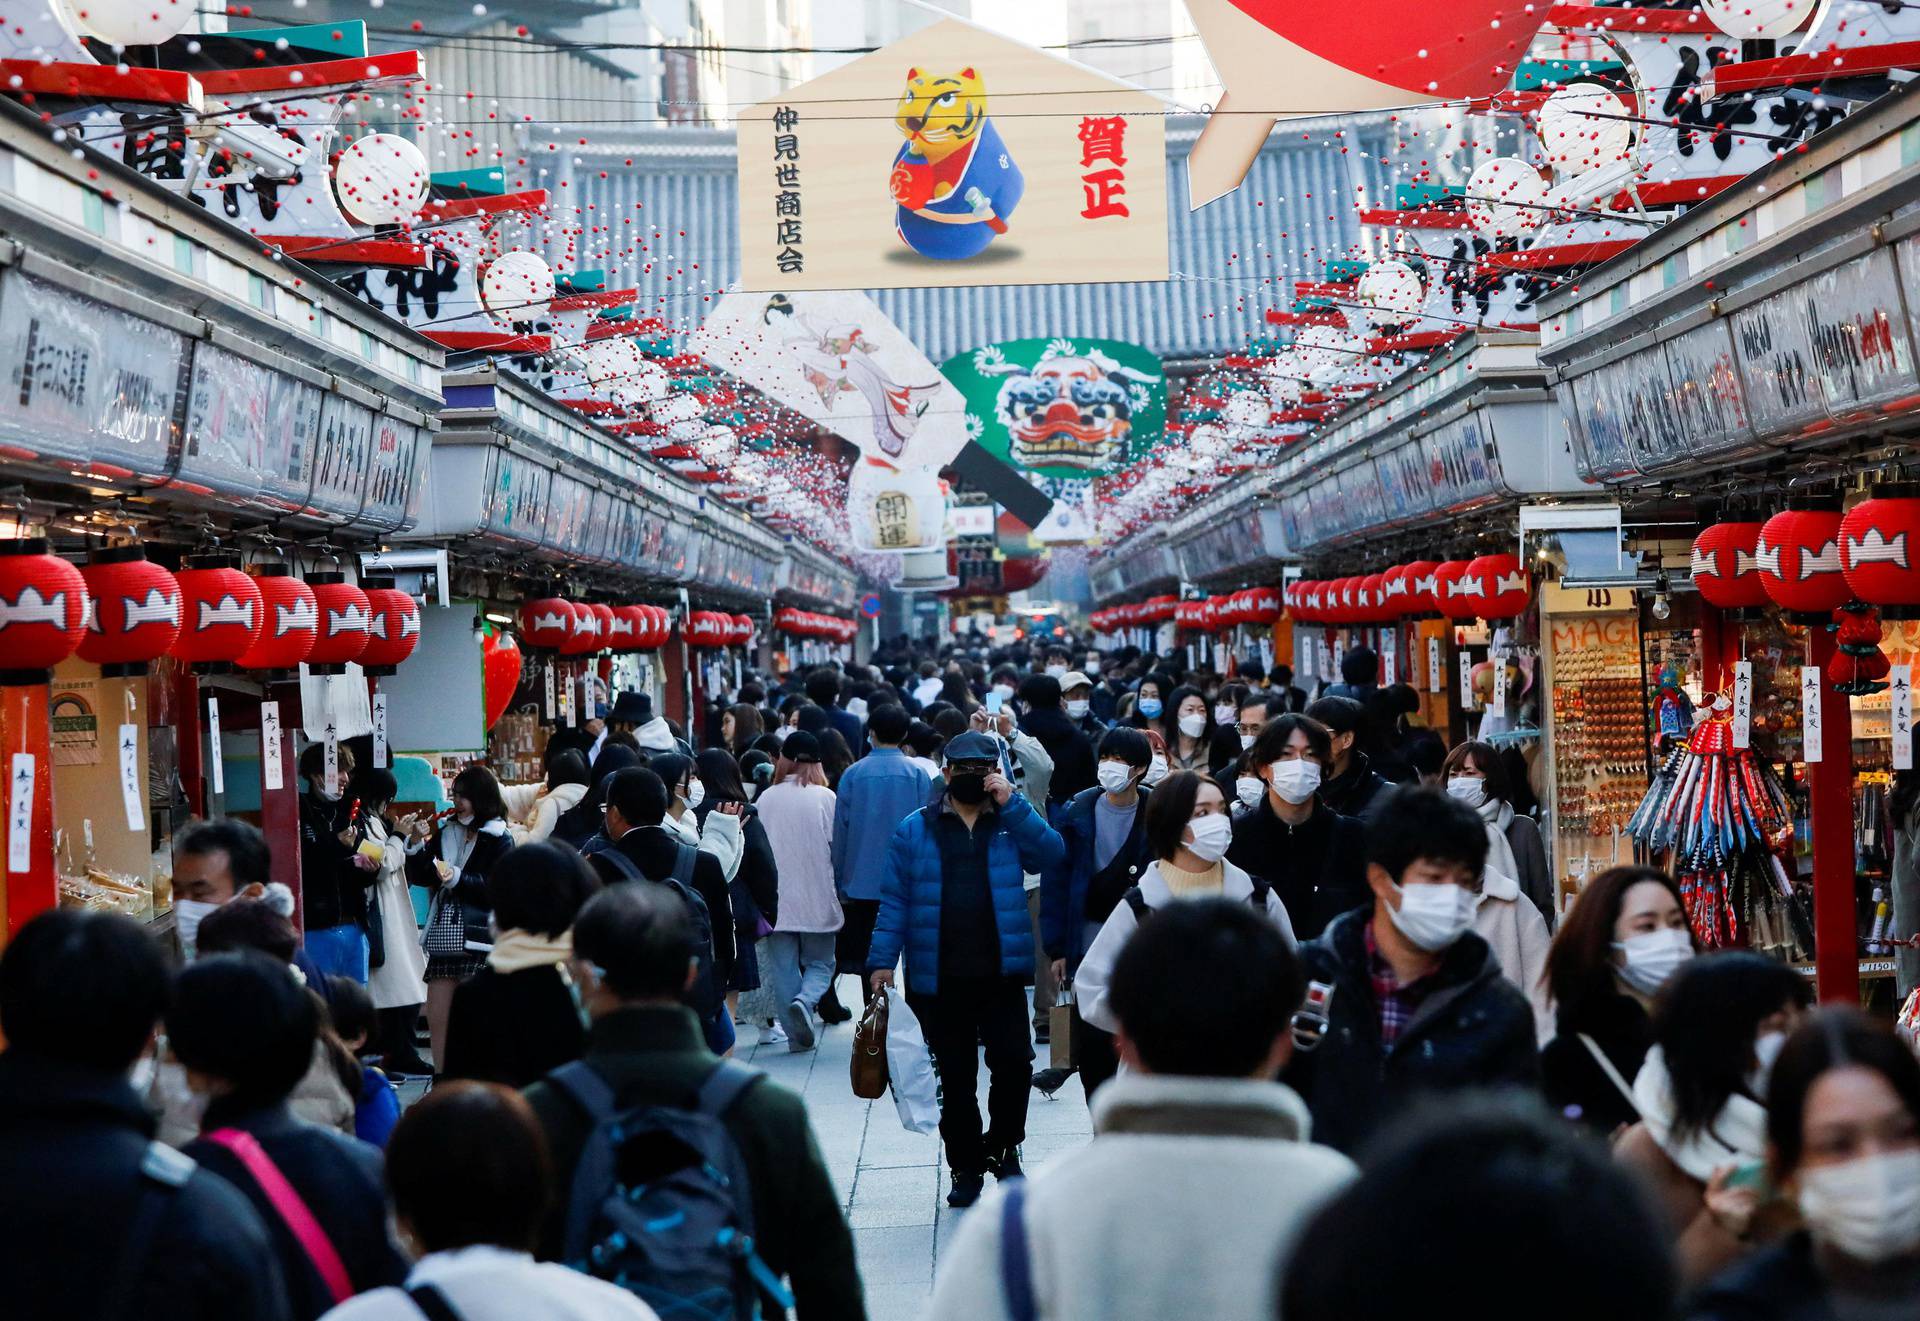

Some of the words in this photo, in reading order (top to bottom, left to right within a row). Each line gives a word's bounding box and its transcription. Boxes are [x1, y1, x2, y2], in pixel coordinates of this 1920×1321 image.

[773, 105, 804, 274] 仲見世商店会
[1077, 115, 1130, 220] 賀正
[874, 491, 910, 546] 開運
